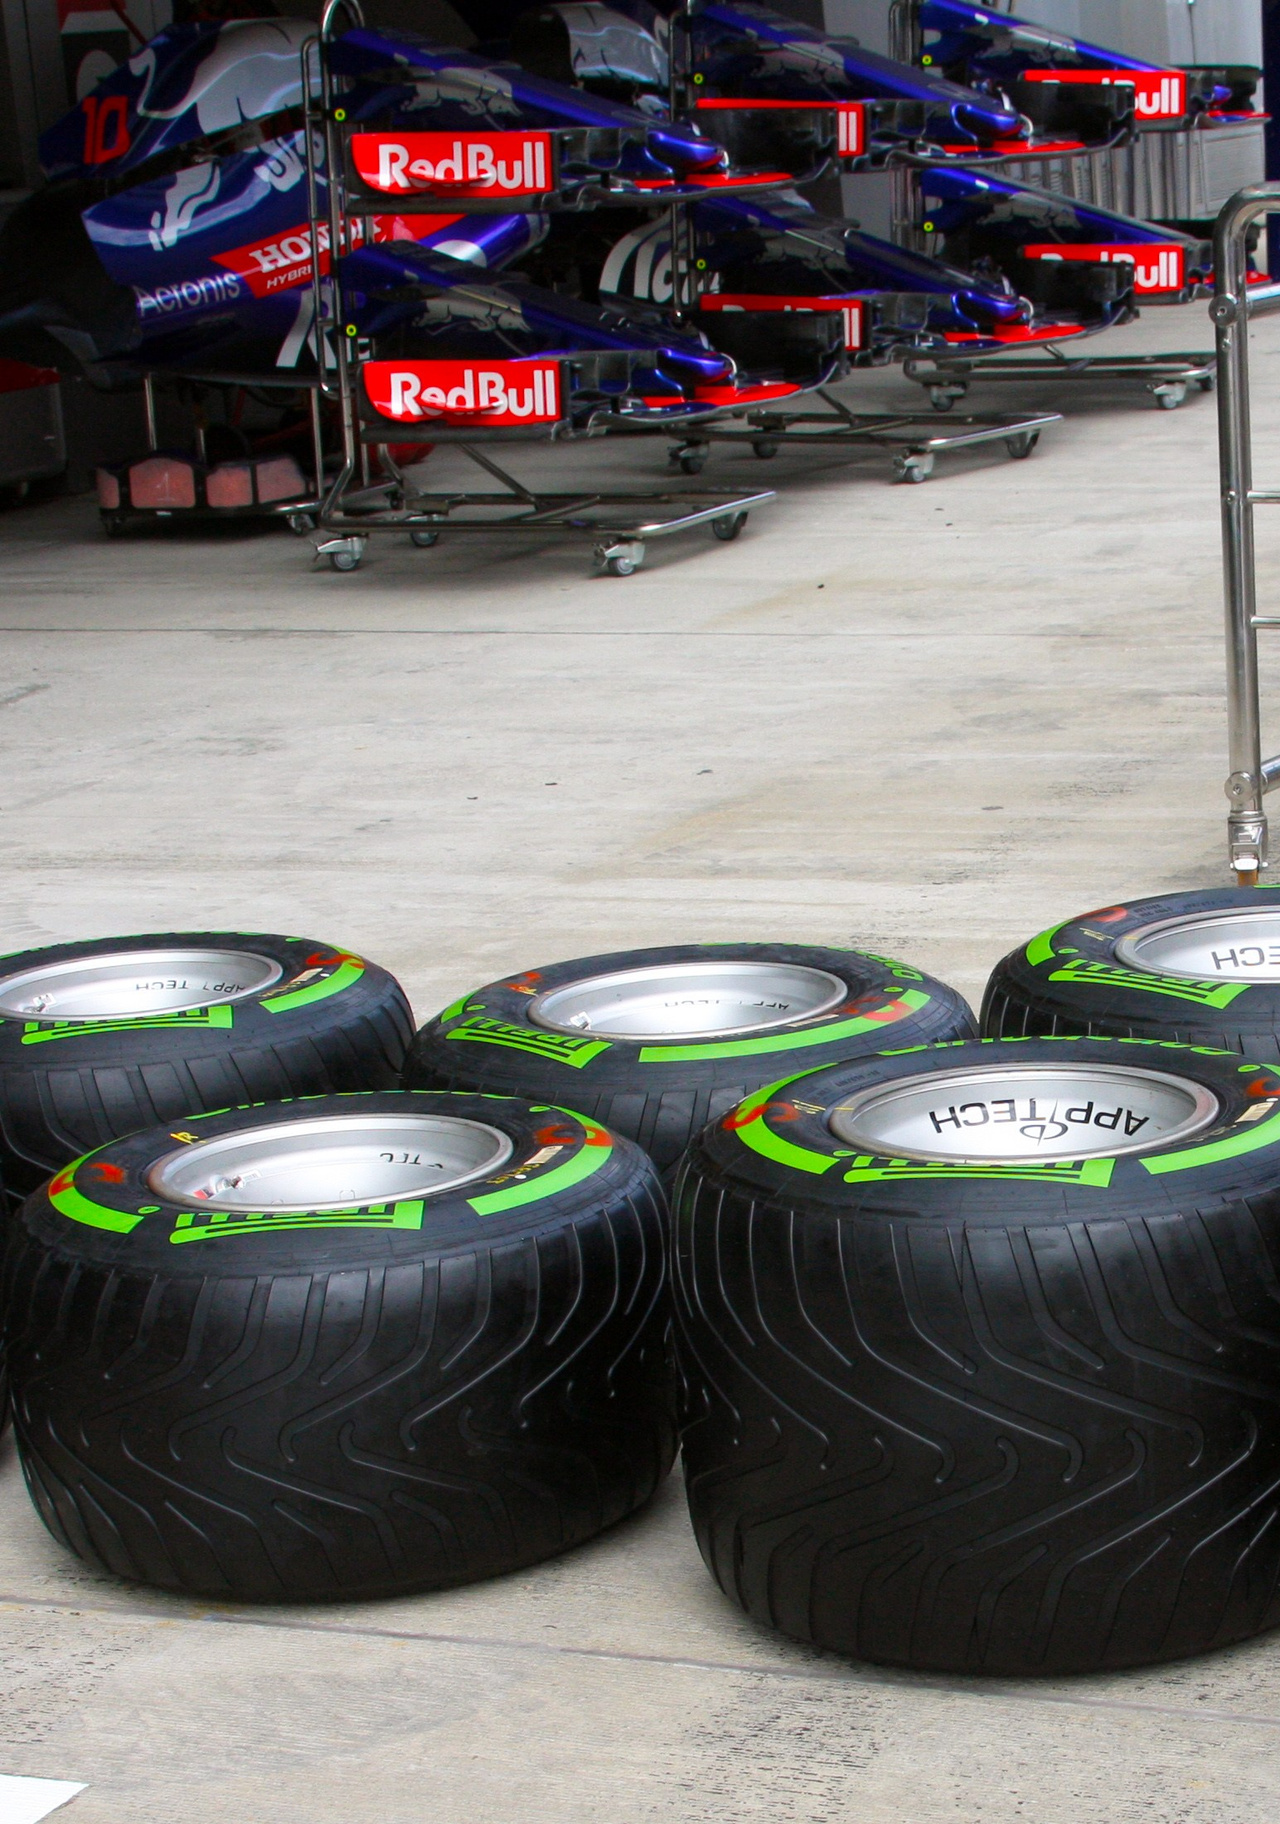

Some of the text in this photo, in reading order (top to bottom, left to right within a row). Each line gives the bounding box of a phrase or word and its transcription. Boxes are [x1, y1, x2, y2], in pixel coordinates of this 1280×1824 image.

[81, 95, 131, 165] 10
[132, 272, 241, 317] Acronis
[266, 264, 313, 289] HYBRI
[445, 1015, 614, 1069] PIRELLI
[929, 1098, 1150, 1136] APP TECH
